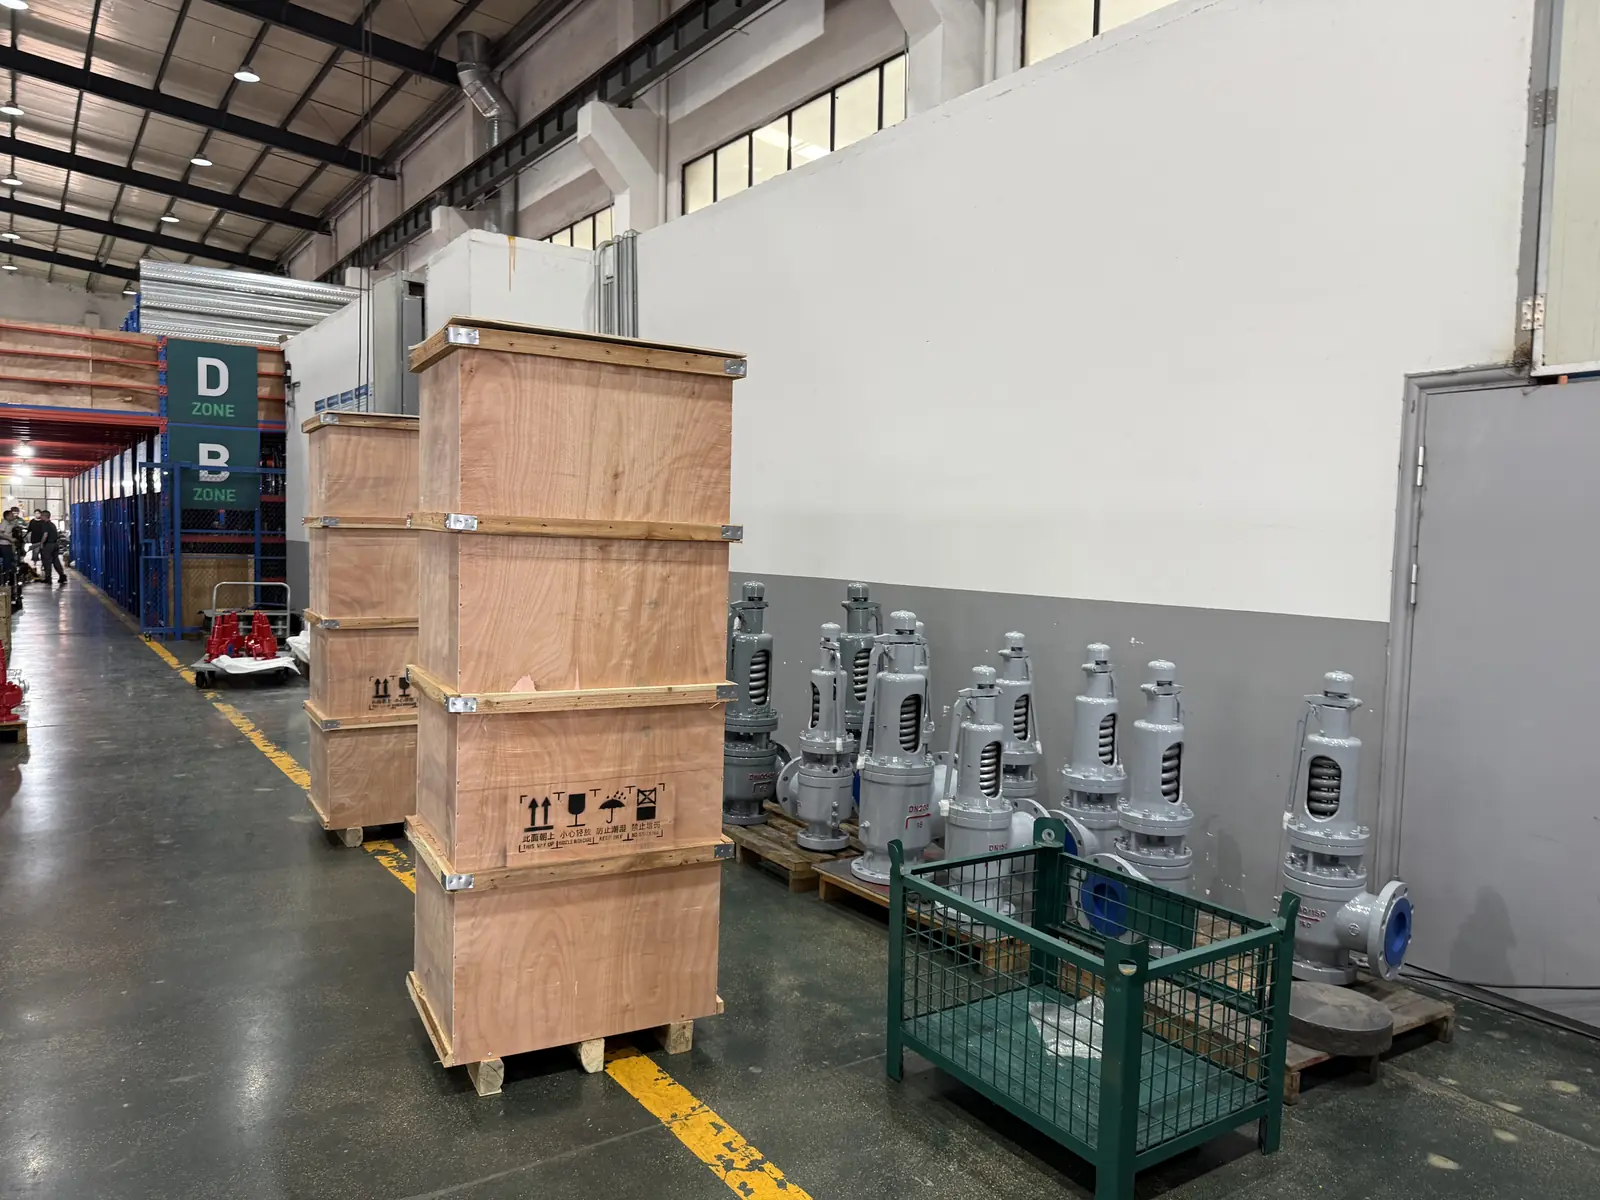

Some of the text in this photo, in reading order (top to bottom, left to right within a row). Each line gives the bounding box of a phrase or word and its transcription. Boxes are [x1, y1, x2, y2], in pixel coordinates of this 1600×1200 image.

[197, 356, 229, 397] D
[191, 402, 235, 418] ZONE
[198, 442, 230, 483] B
[192, 487, 237, 502] ZONE
[560, 828, 592, 839] 小心轻放
